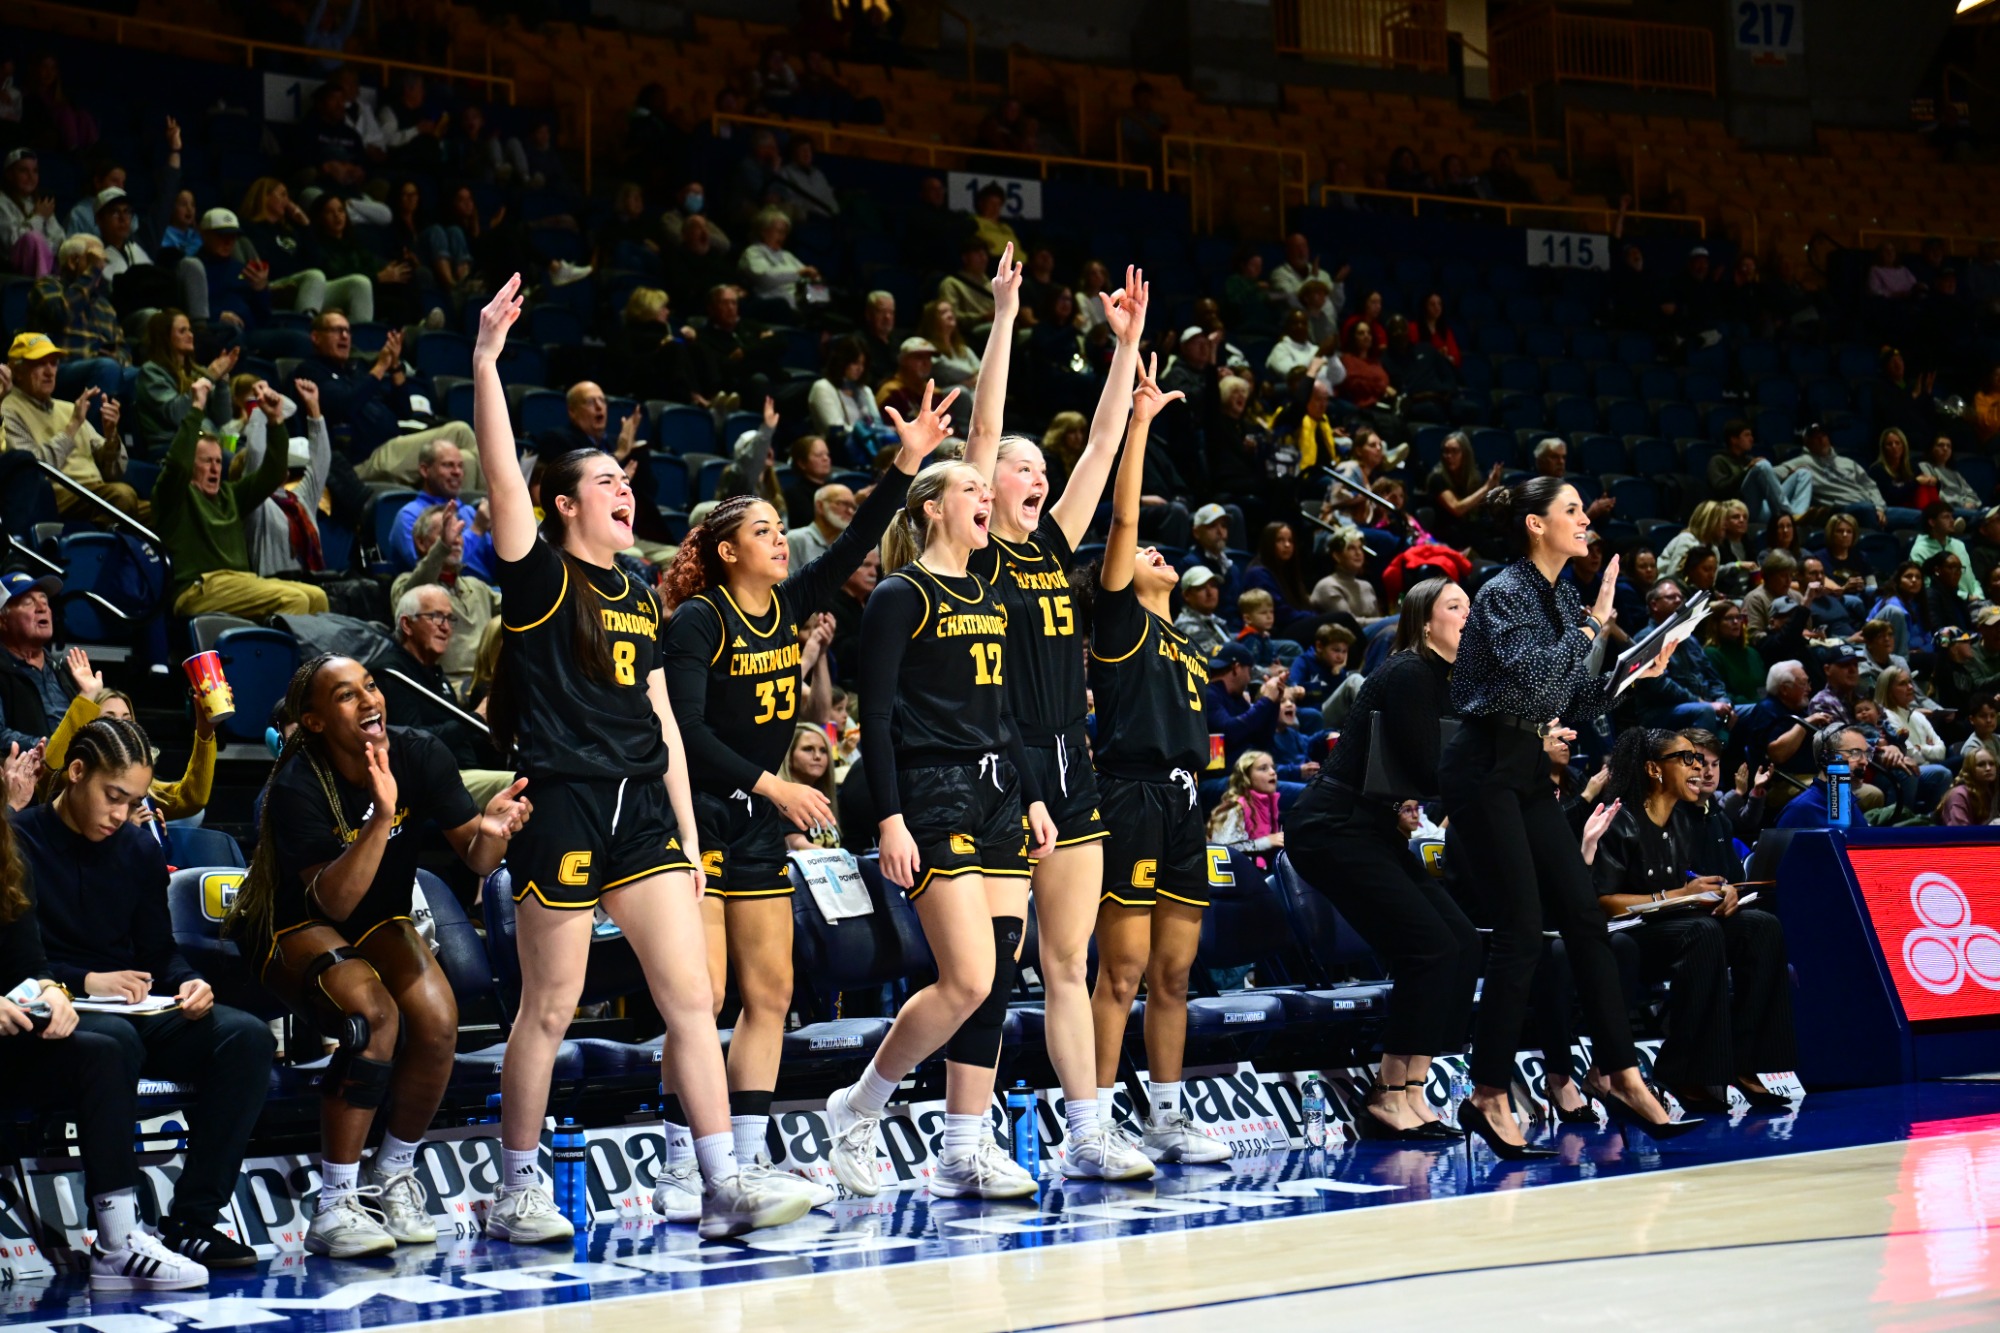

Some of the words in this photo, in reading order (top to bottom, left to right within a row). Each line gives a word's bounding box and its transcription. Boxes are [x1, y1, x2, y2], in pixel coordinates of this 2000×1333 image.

[1738, 1, 1794, 47] 217
[966, 179, 1022, 214] 15
[1543, 235, 1594, 266] 115
[1038, 596, 1074, 636] 15
[613, 640, 636, 686] 8
[969, 643, 1003, 686] 12
[754, 676, 796, 725] 33
[1831, 774, 1839, 819] POWERADE
[558, 851, 592, 885] C
[811, 1035, 862, 1049] CHATTANOOGA
[1229, 1137, 1271, 1153] ORTON
[1241, 1120, 1280, 1133] GROUP
